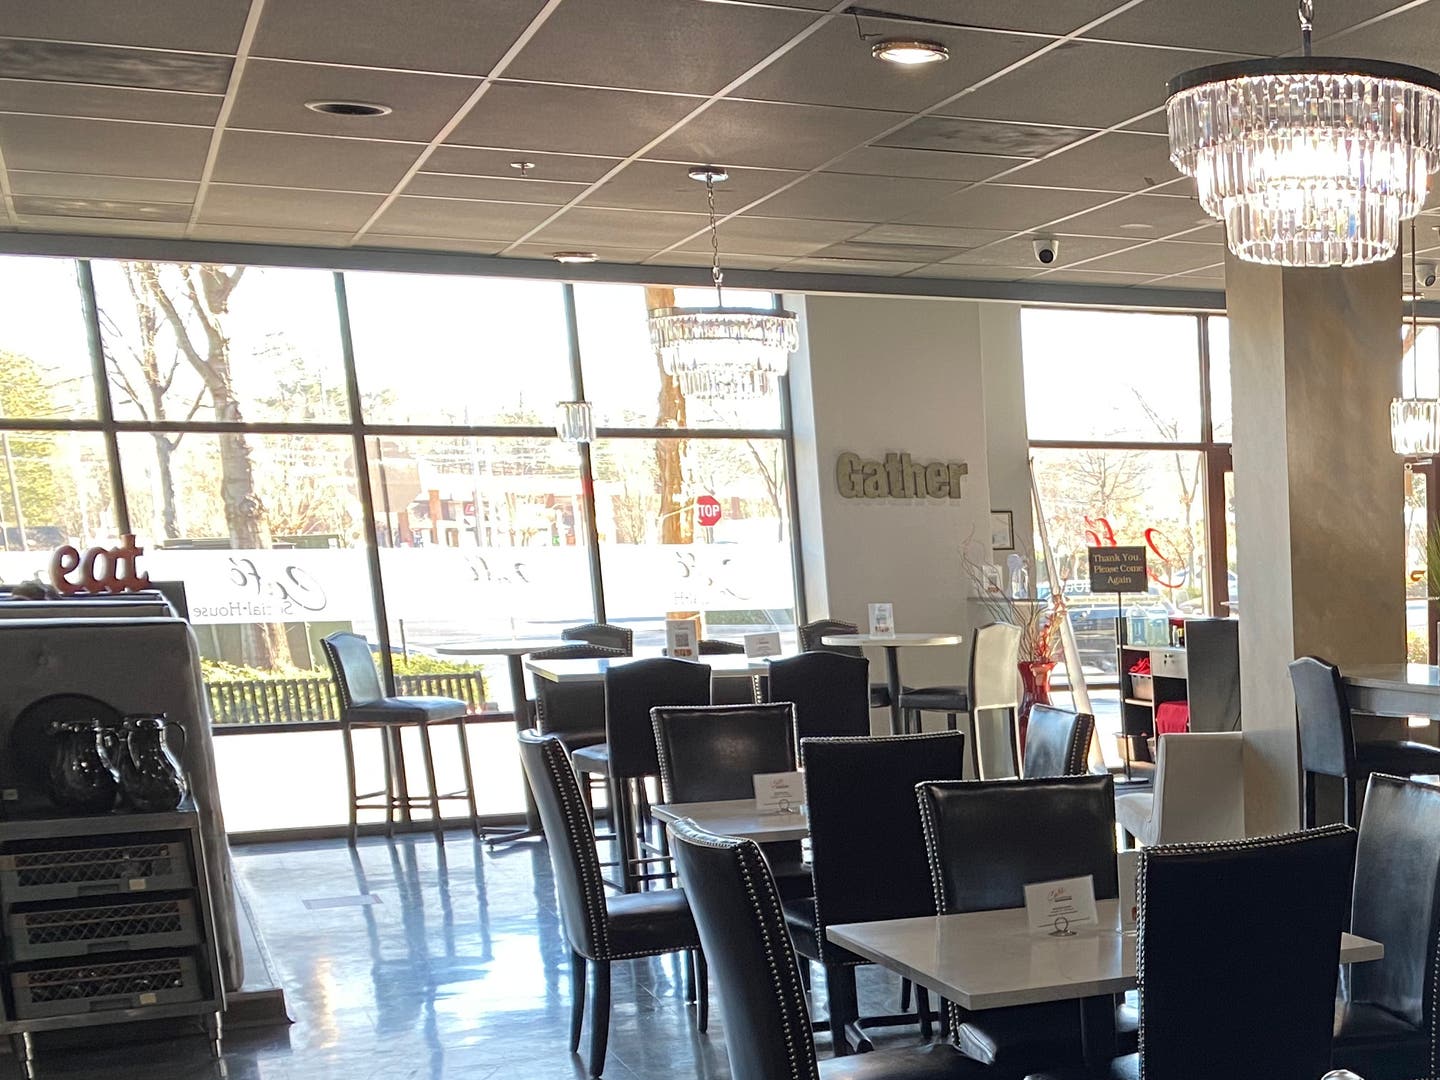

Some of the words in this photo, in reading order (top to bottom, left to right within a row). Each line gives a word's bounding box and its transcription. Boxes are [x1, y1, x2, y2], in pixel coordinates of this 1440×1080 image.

[836, 451, 968, 499] Gather
[1093, 553, 1121, 562] Thank
[50, 534, 150, 594] eat
[1094, 565, 1119, 574] Please
[1120, 564, 1144, 573] Come
[1107, 575, 1132, 586] Again
